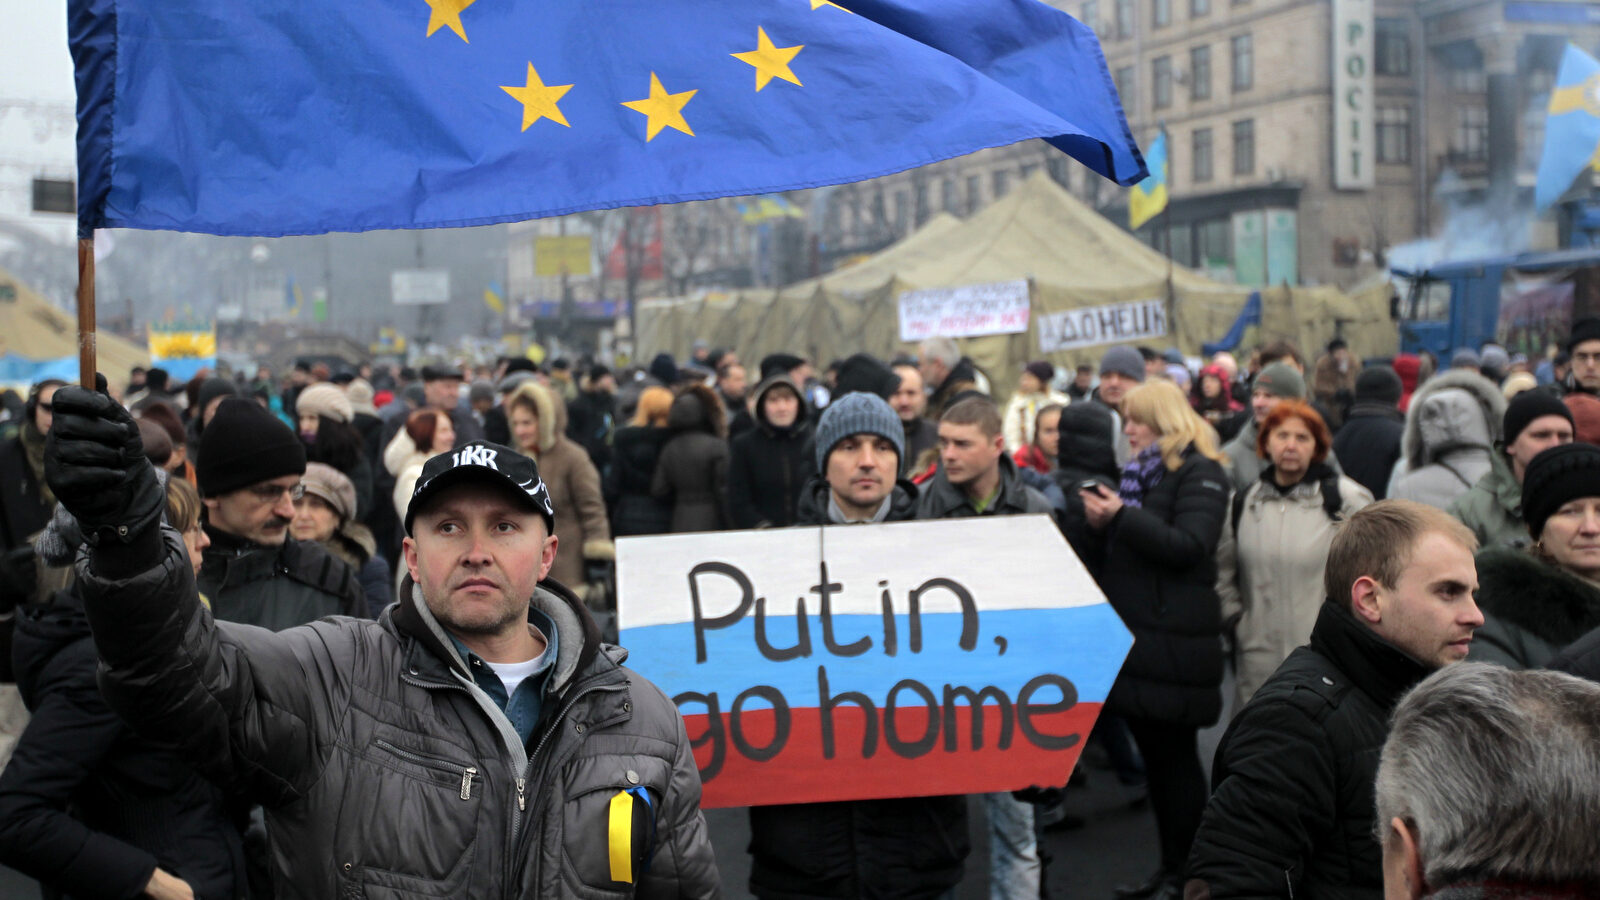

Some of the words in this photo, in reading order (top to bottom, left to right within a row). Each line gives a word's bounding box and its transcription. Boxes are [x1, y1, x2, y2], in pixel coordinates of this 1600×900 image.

[1060, 303, 1167, 343] ДОНЕЦК
[688, 561, 1007, 664] Putin,
[672, 685, 791, 784] go
[818, 666, 1080, 760] home
